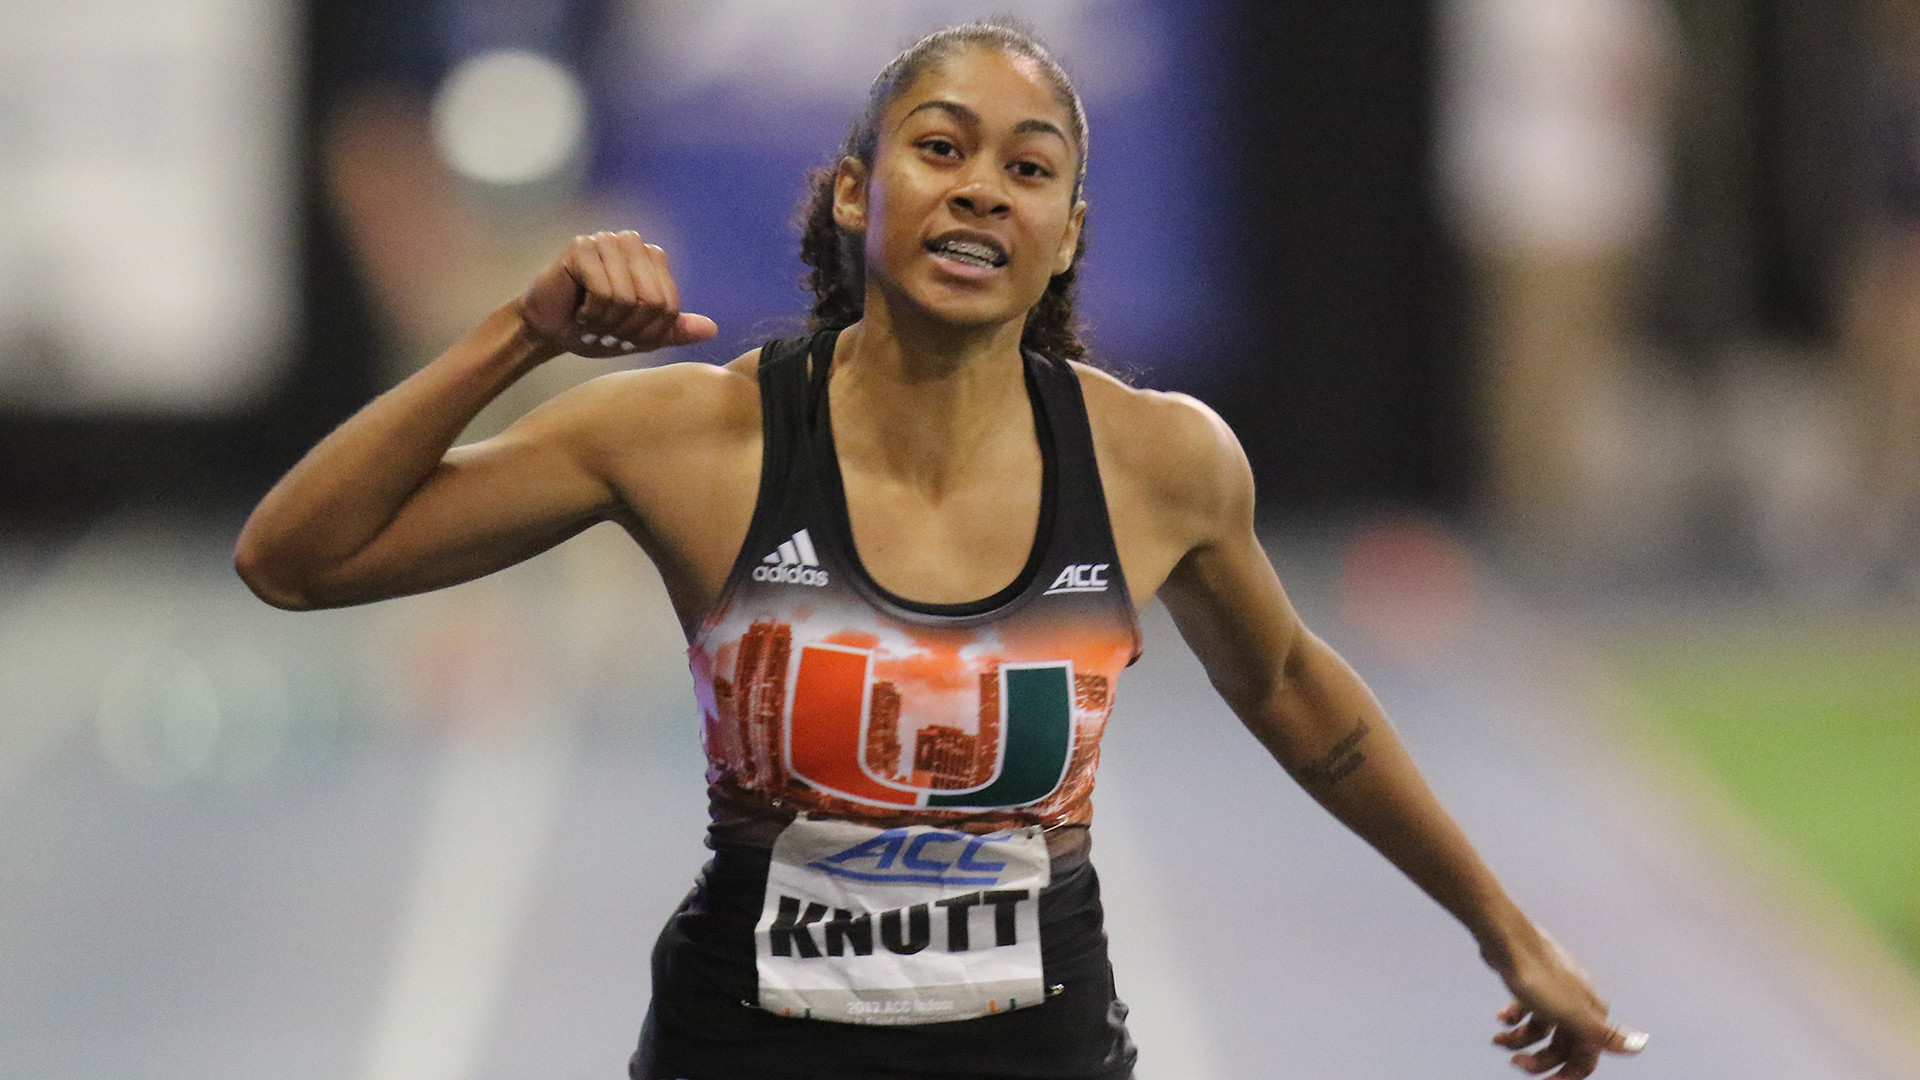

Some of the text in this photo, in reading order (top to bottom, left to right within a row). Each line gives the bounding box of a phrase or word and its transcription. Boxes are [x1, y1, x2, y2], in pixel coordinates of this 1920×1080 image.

[753, 563, 829, 587] adidas
[1048, 562, 1110, 589] ACC
[784, 642, 1076, 811] U
[820, 829, 1011, 874] ACC
[770, 890, 1030, 959] KNUTT
